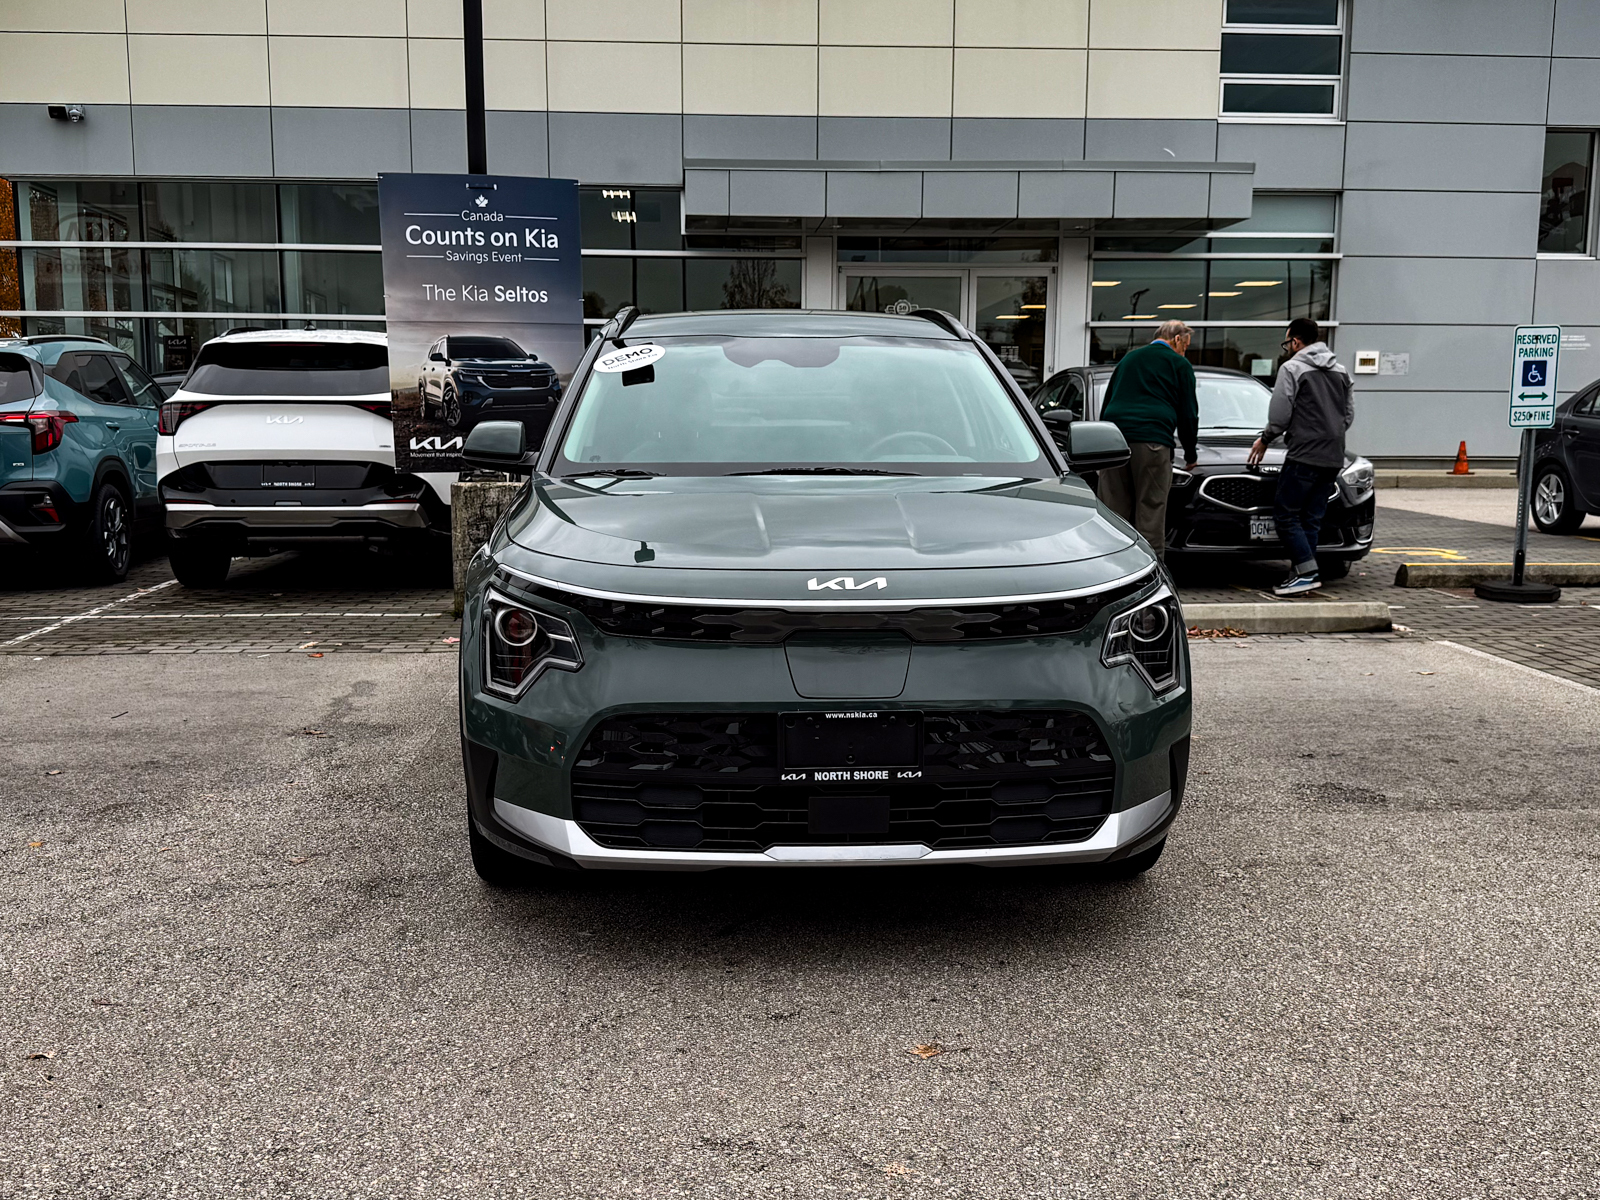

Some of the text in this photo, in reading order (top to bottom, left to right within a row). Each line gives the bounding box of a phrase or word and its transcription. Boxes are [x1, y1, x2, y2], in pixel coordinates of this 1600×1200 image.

[461, 210, 504, 222] Canada
[405, 225, 559, 249] Counts on Kia
[446, 251, 522, 264] Savings Event
[422, 284, 549, 303] The Kia Seltos
[1516, 334, 1558, 345] RESERVED
[602, 347, 653, 366] DEMO
[1518, 347, 1554, 358] PARKING
[265, 415, 304, 424] KIA
[1513, 411, 1551, 422] $250 FINE
[409, 436, 463, 450] KIA
[807, 577, 888, 591] KIA
[825, 711, 878, 719] www.nskia.ca
[781, 773, 806, 781] KIA
[814, 772, 850, 781] NORTH
[853, 771, 889, 780] SHORE
